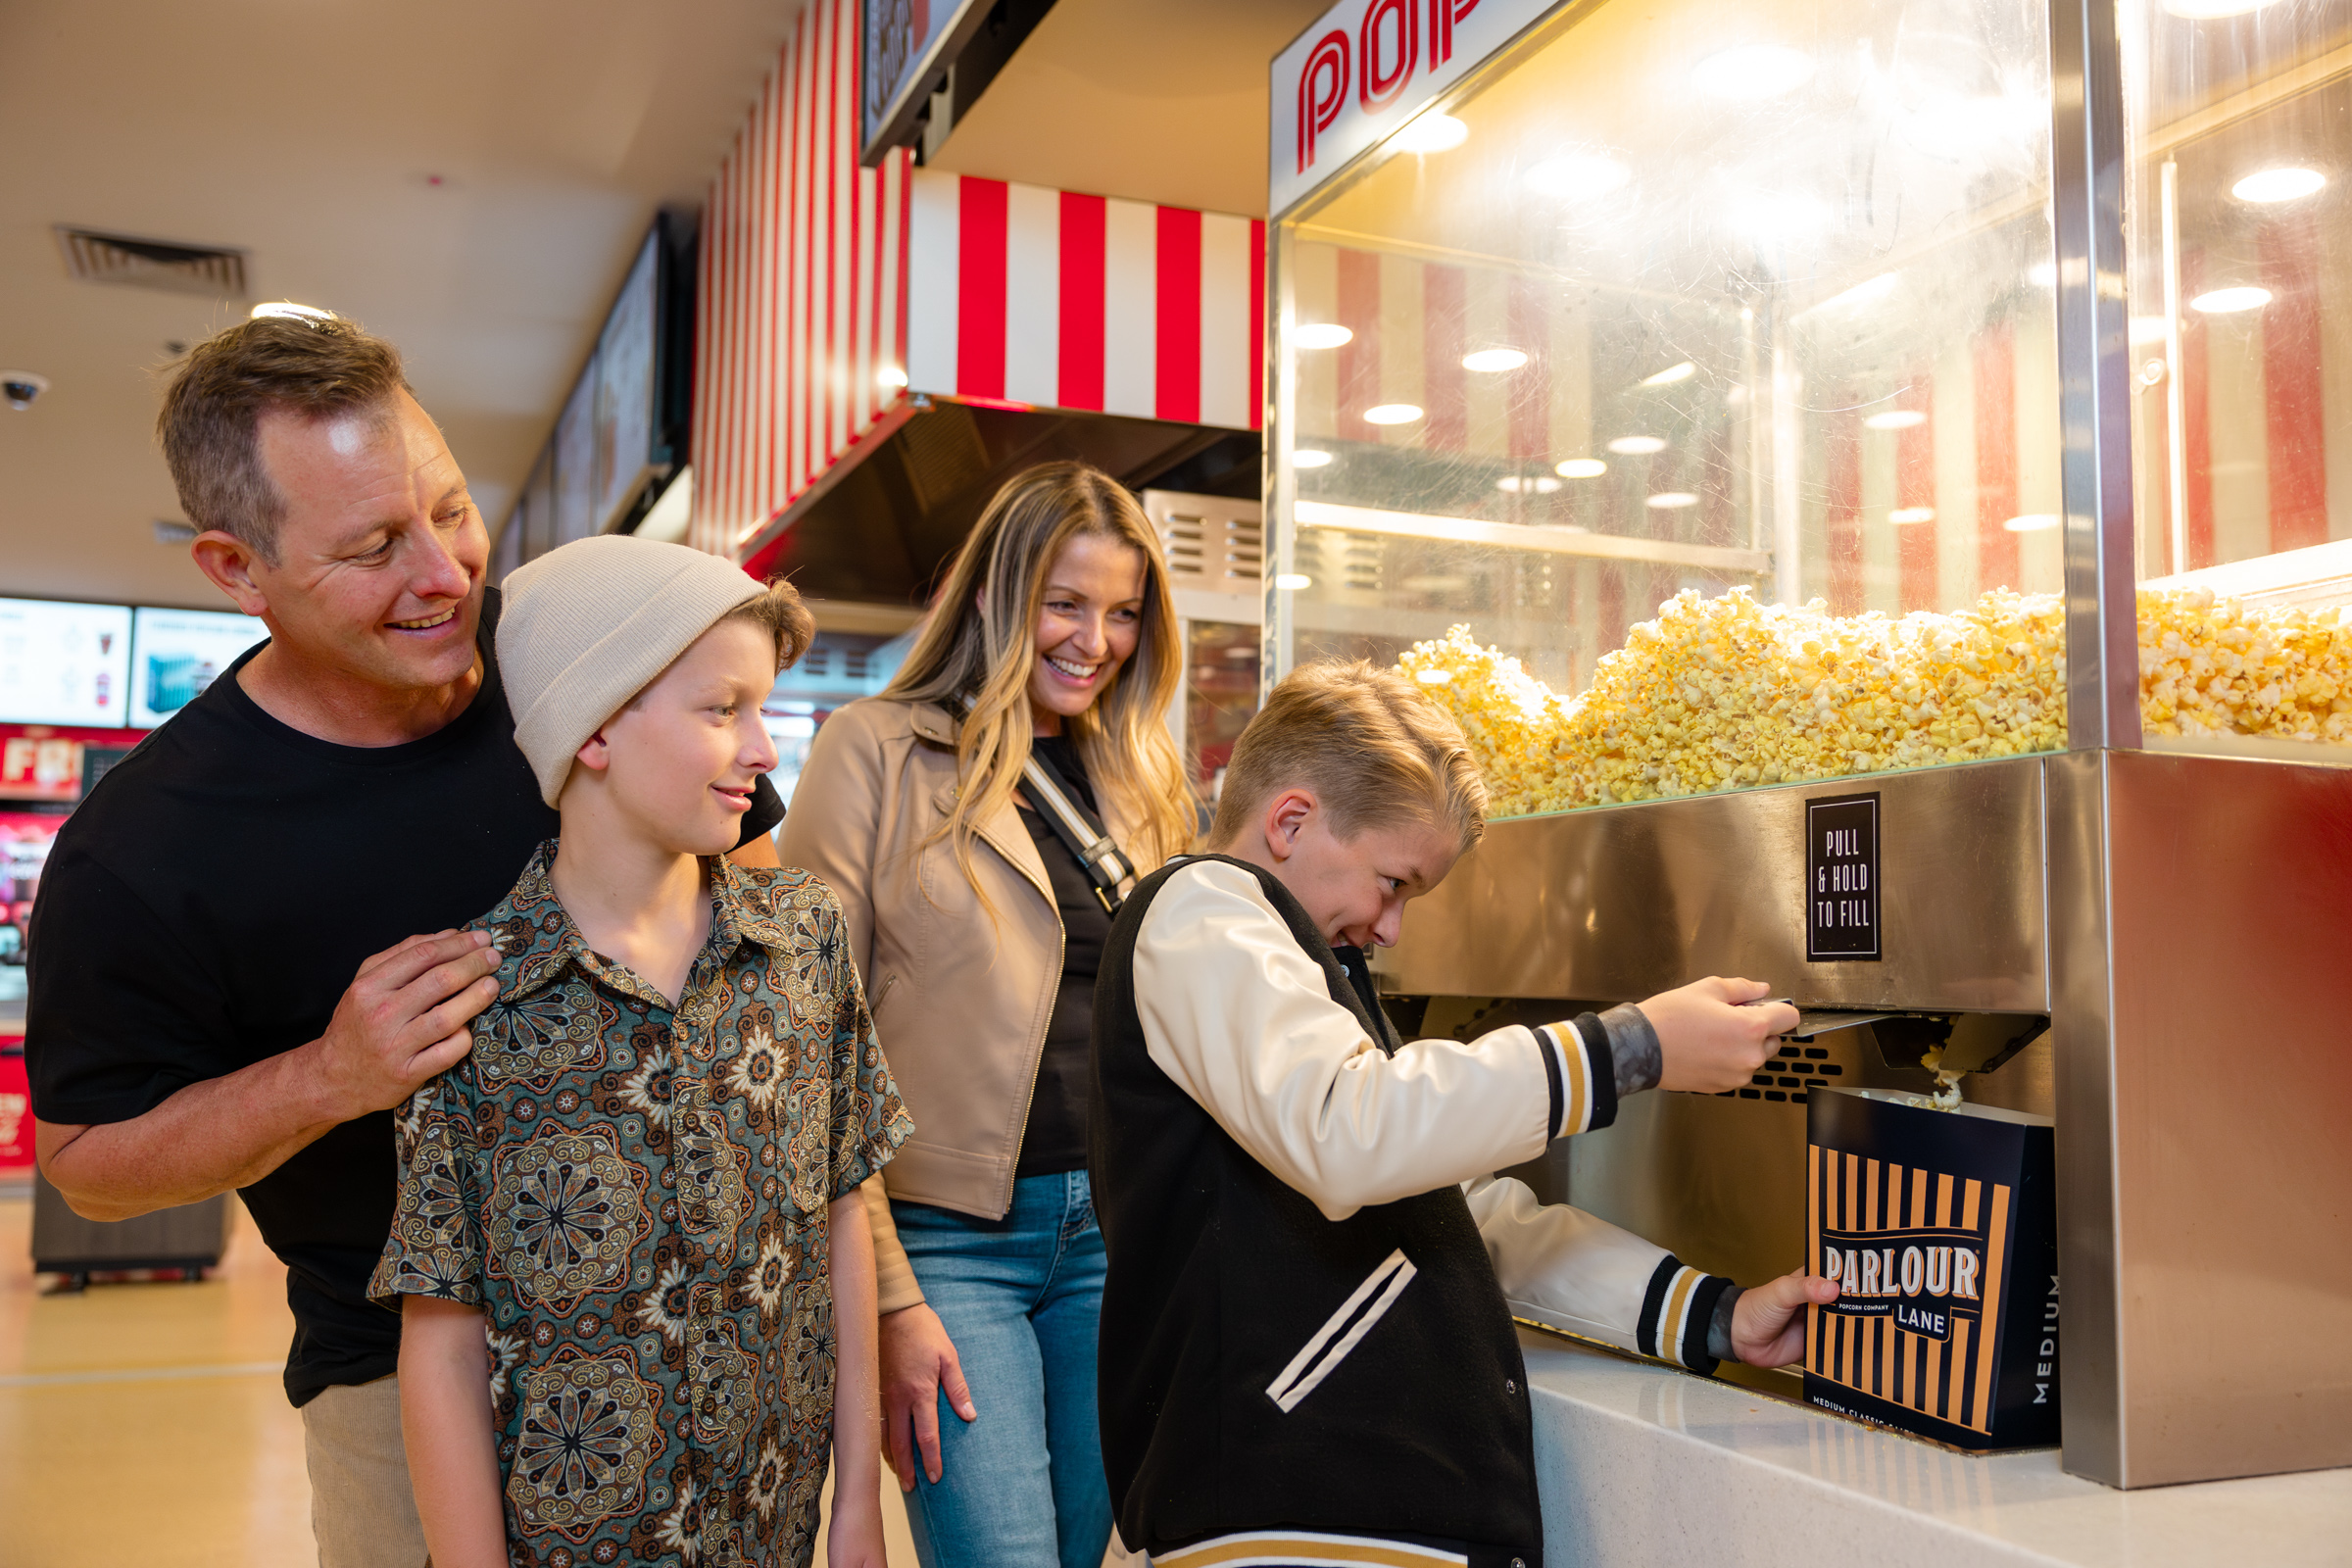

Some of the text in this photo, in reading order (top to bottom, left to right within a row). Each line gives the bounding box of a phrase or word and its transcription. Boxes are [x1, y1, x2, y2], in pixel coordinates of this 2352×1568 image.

[1827, 829, 1859, 858] PULL
[1818, 863, 1868, 893] & HOLD
[1818, 900, 1870, 928] TO FILL
[1826, 1246, 1980, 1300] PARLOUR
[1898, 1304, 1945, 1334] LANE
[2033, 1275, 2060, 1403] MEDIUM
[1813, 1396, 1845, 1413] MEDIUM
